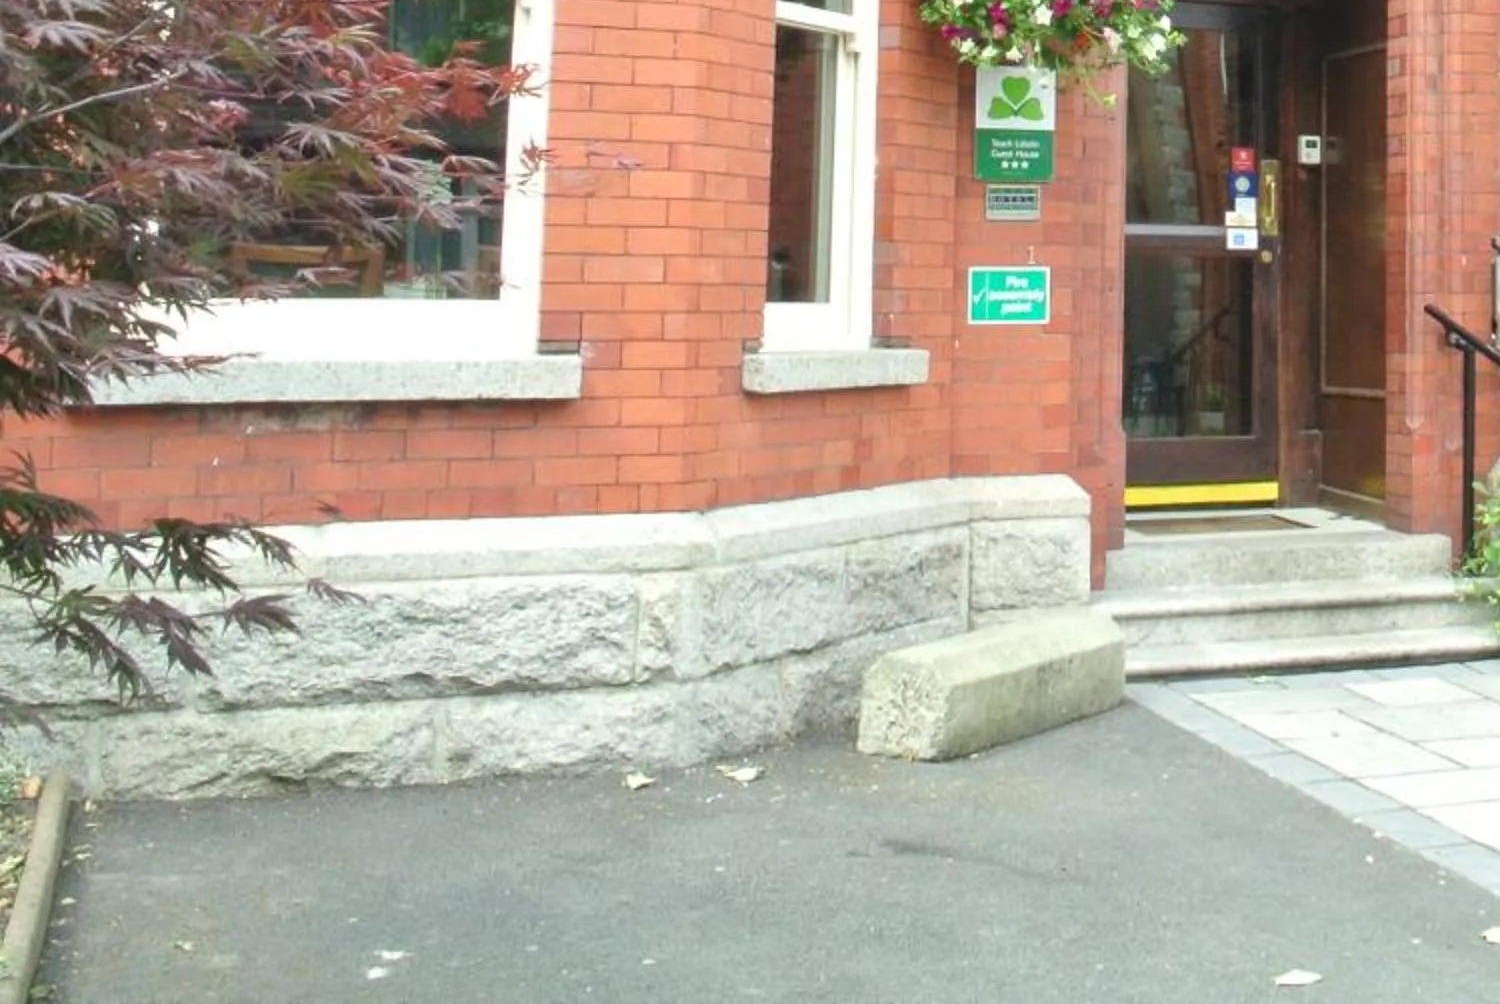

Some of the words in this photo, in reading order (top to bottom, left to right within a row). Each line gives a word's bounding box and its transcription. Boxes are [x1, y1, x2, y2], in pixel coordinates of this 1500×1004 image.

[991, 149, 1013, 158] Guest
[1015, 150, 1039, 158] House
[1005, 276, 1029, 288] Fire
[989, 289, 1044, 303] assembly
[1001, 303, 1032, 316] point
